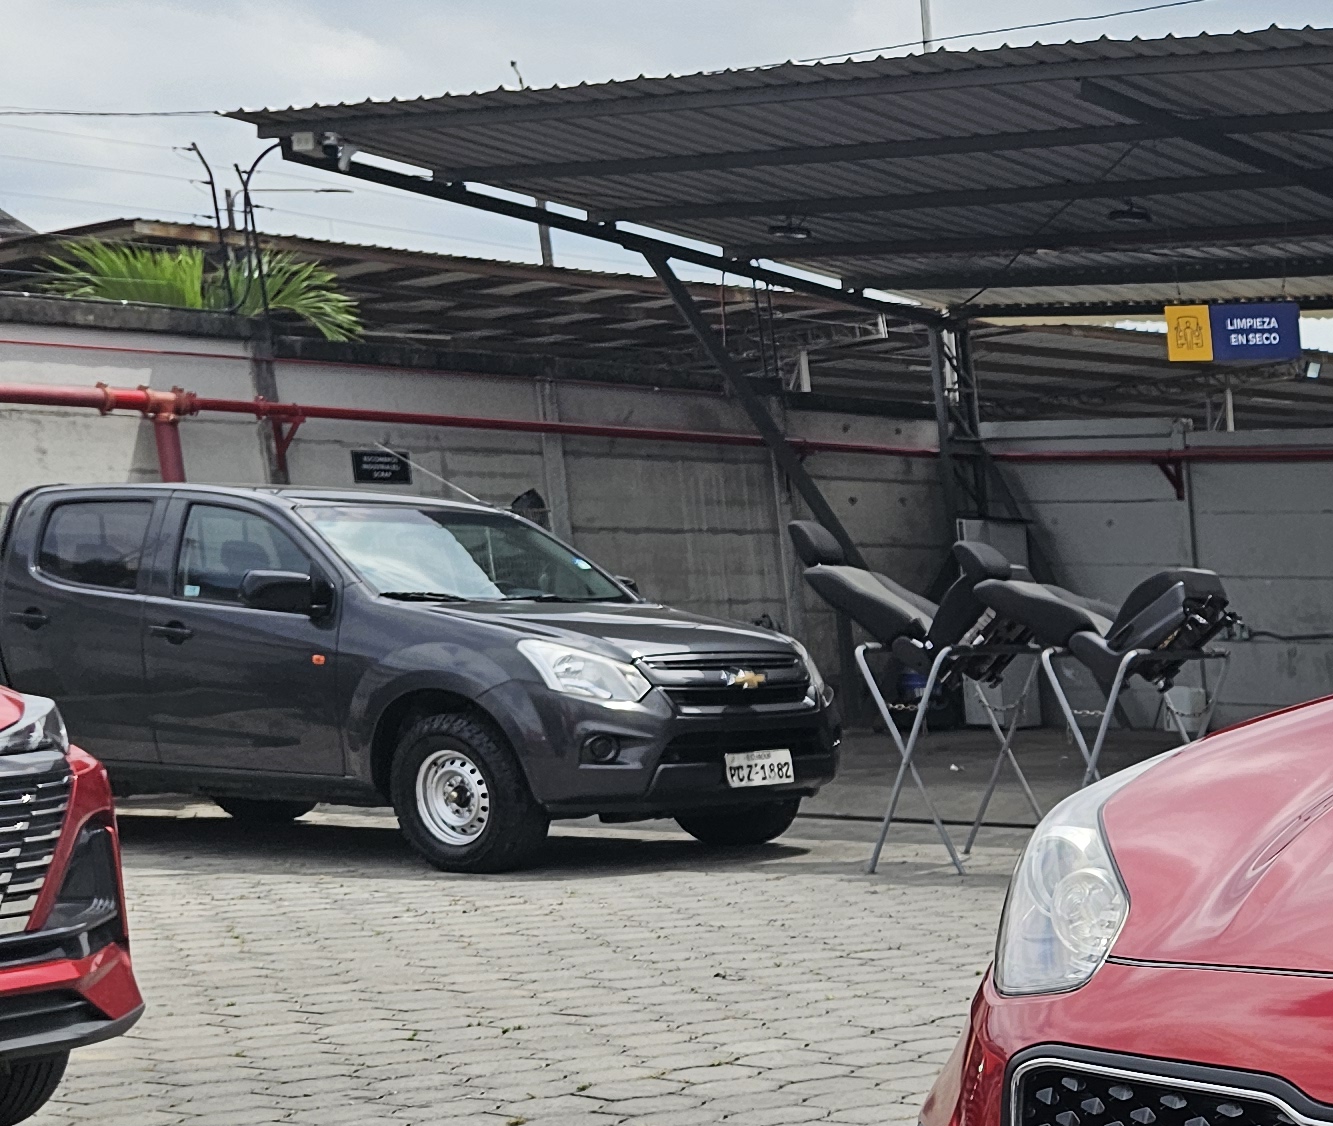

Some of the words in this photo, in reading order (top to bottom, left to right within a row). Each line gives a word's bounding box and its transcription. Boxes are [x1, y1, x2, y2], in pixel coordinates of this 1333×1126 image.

[1226, 316, 1279, 330] LIMPIEZA
[1229, 333, 1247, 346] EN
[1247, 332, 1280, 345] SECO
